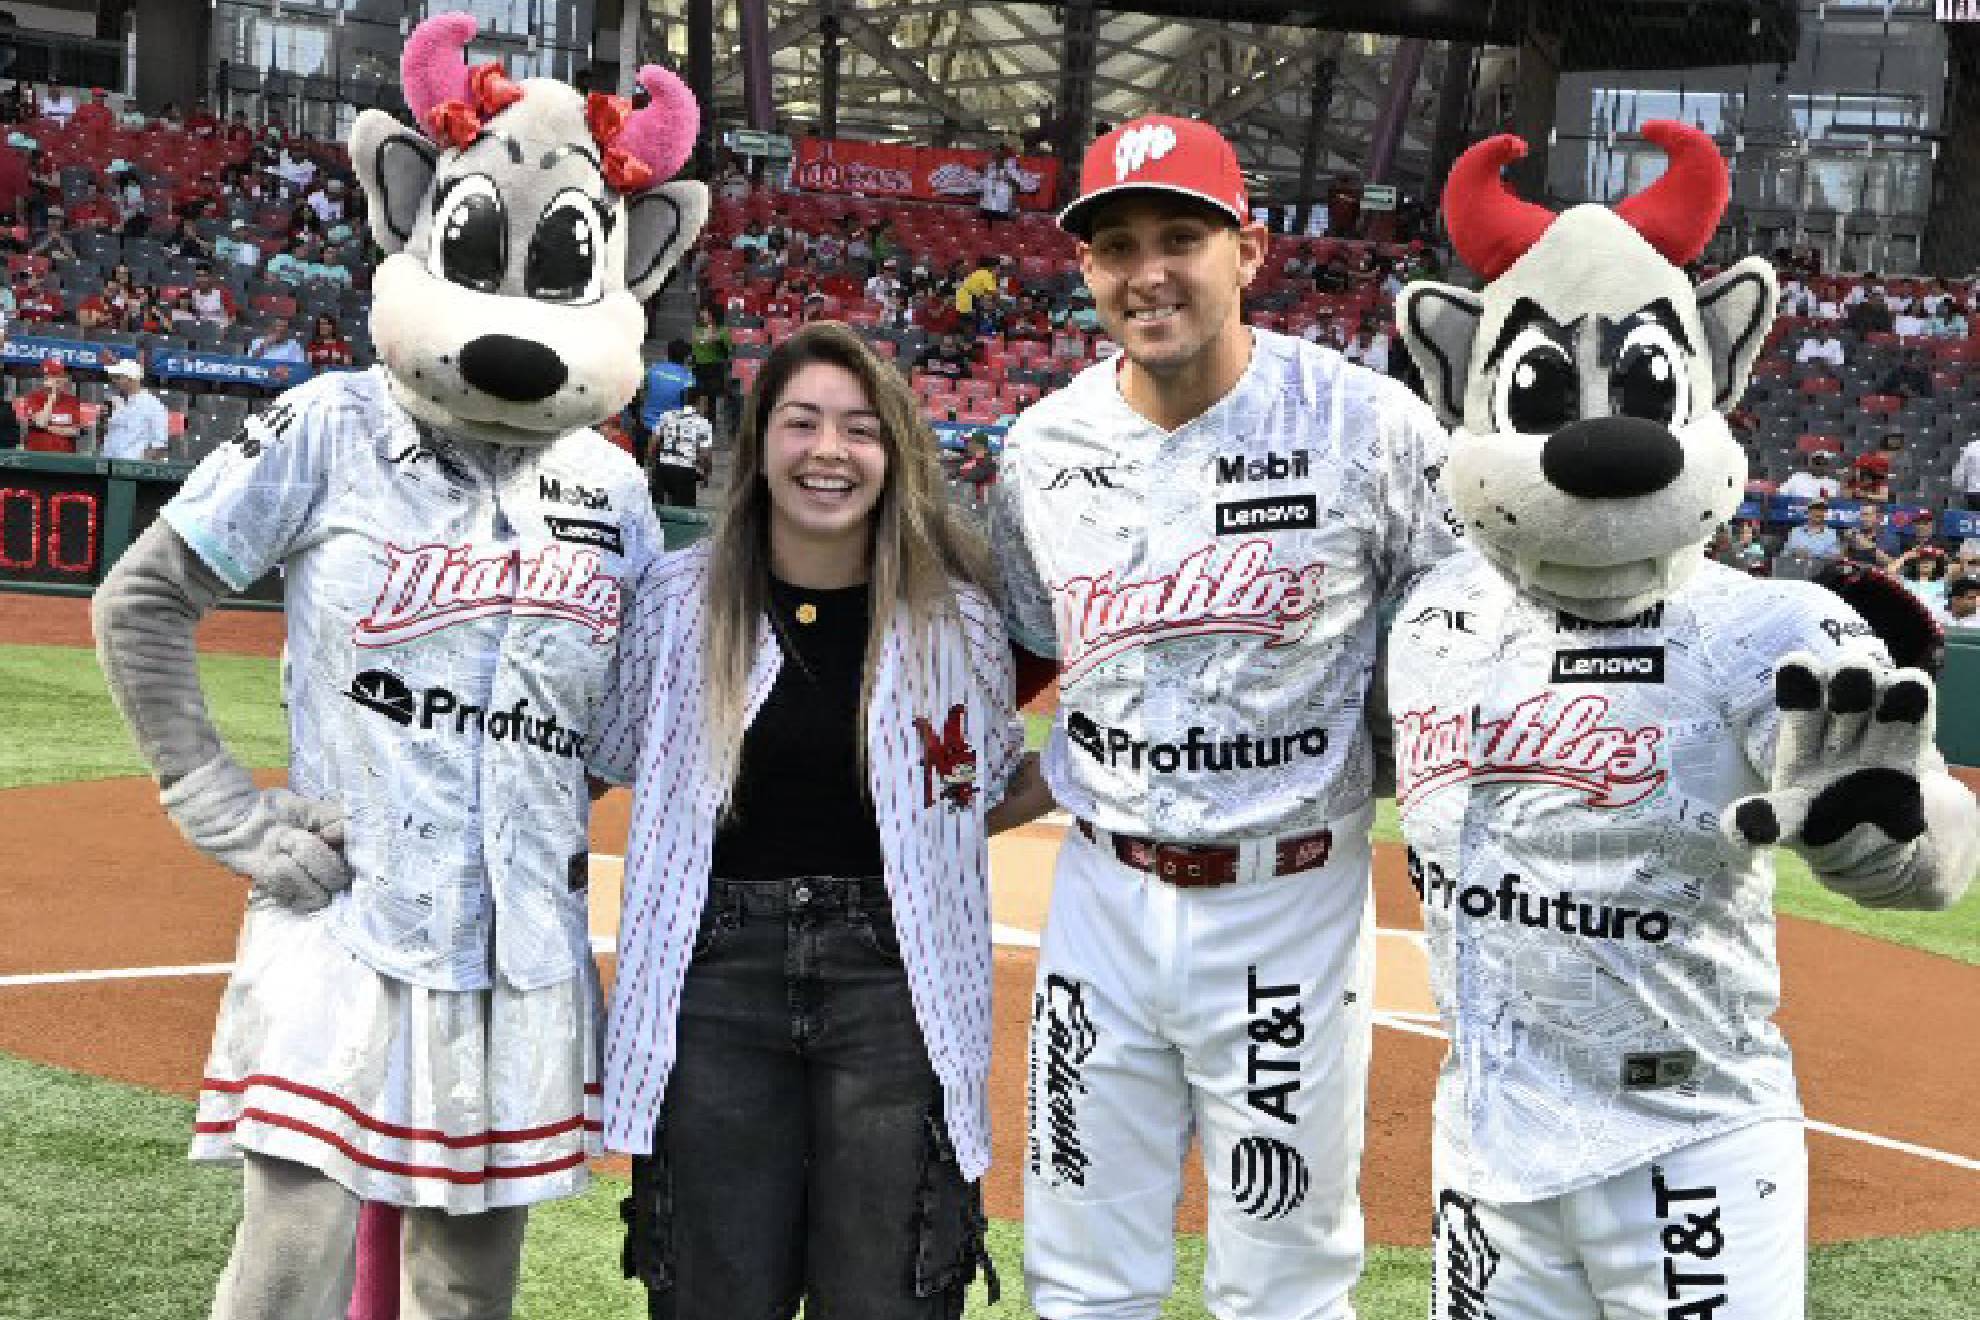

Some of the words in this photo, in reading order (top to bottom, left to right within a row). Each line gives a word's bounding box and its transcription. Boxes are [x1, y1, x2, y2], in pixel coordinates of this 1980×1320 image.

[1216, 449, 1309, 484] Mobil
[1222, 503, 1309, 527] Lenovo
[1559, 656, 1653, 675] Lenovo
[1106, 726, 1329, 773] Profuturo
[1426, 861, 1669, 942] Profuturo
[1247, 963, 1305, 1125] AT&T
